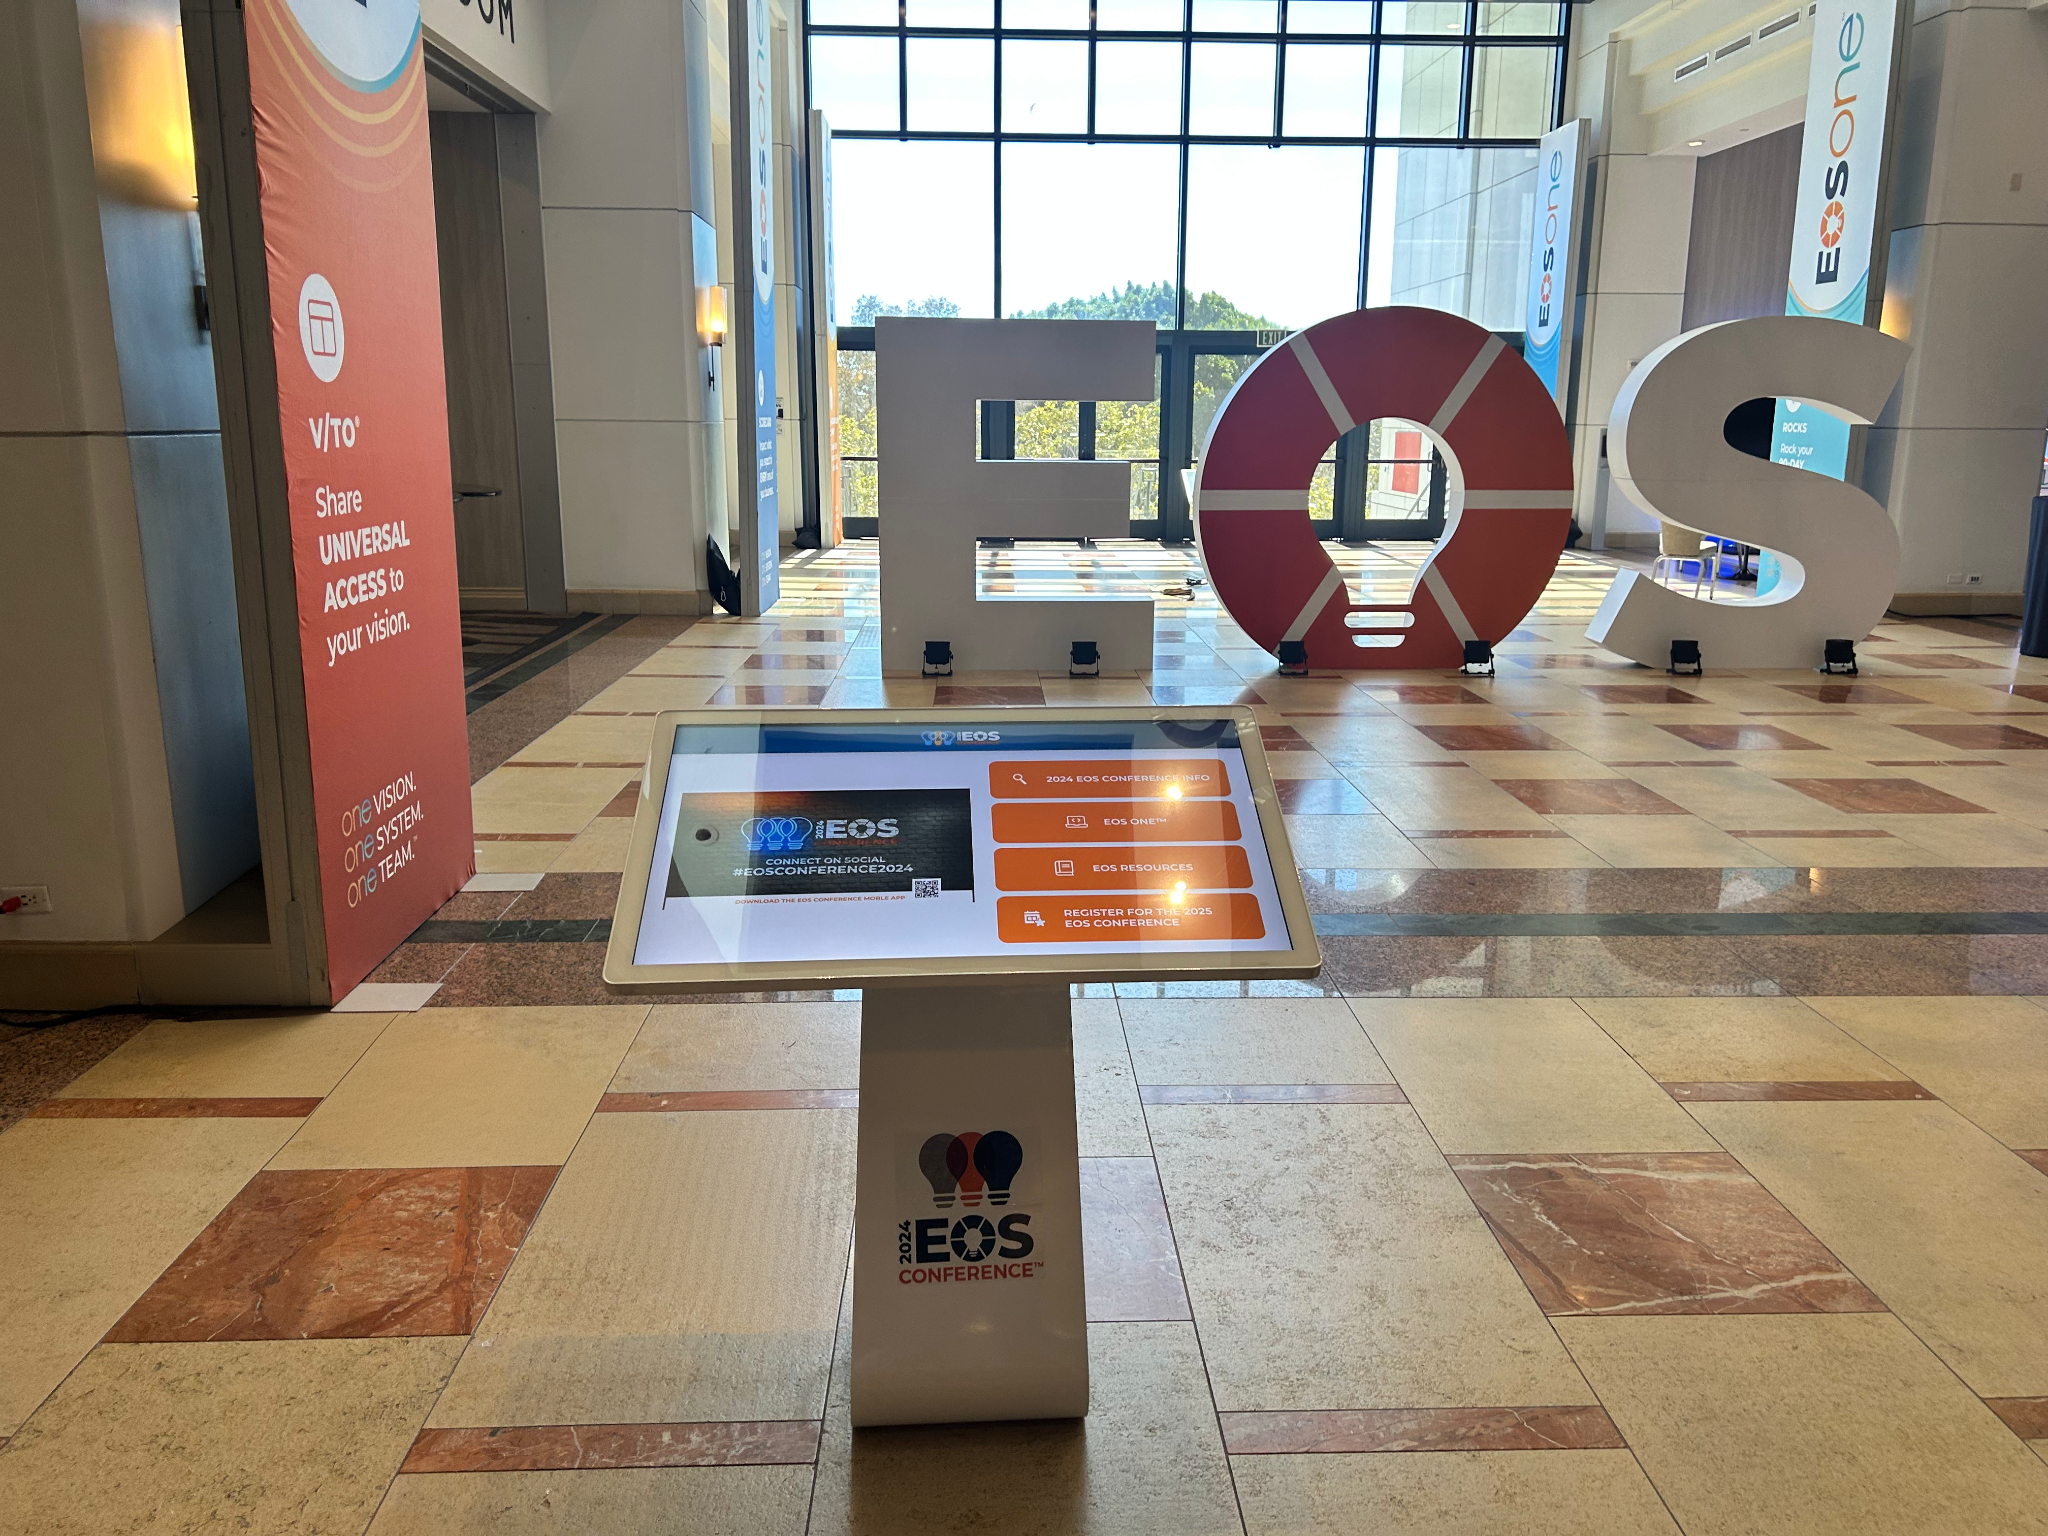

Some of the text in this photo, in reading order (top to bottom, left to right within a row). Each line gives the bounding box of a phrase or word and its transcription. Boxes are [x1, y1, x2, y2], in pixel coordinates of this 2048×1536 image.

[1262, 331, 1282, 345] EXIT
[1782, 422, 1808, 433] ROCKS
[1780, 443, 1814, 458] Rock your
[315, 485, 362, 518] Share
[318, 520, 410, 566] UNIVERSAL
[324, 568, 404, 613] ACCESS to
[326, 608, 411, 667] your vision.
[961, 731, 1001, 742] EOS
[1046, 774, 1210, 783] 2024 EOS CONFERENCE INFO
[341, 771, 417, 837] one VISION.
[815, 818, 900, 839] 2024 EOS
[1103, 817, 1128, 826] EOS
[344, 800, 424, 873] one SYSTEM.
[765, 857, 822, 866] CONNECT
[844, 856, 887, 864] SOCIAL
[1092, 863, 1194, 872] EOS RESOURCES
[732, 864, 914, 877] #EOSCONFERENCE2024
[347, 868, 378, 908] one
[1063, 907, 1213, 917] REGISTER FOR THE 2025
[1064, 918, 1180, 928] EOS CONFERENCE
[898, 1213, 1034, 1265] 2024 EOS
